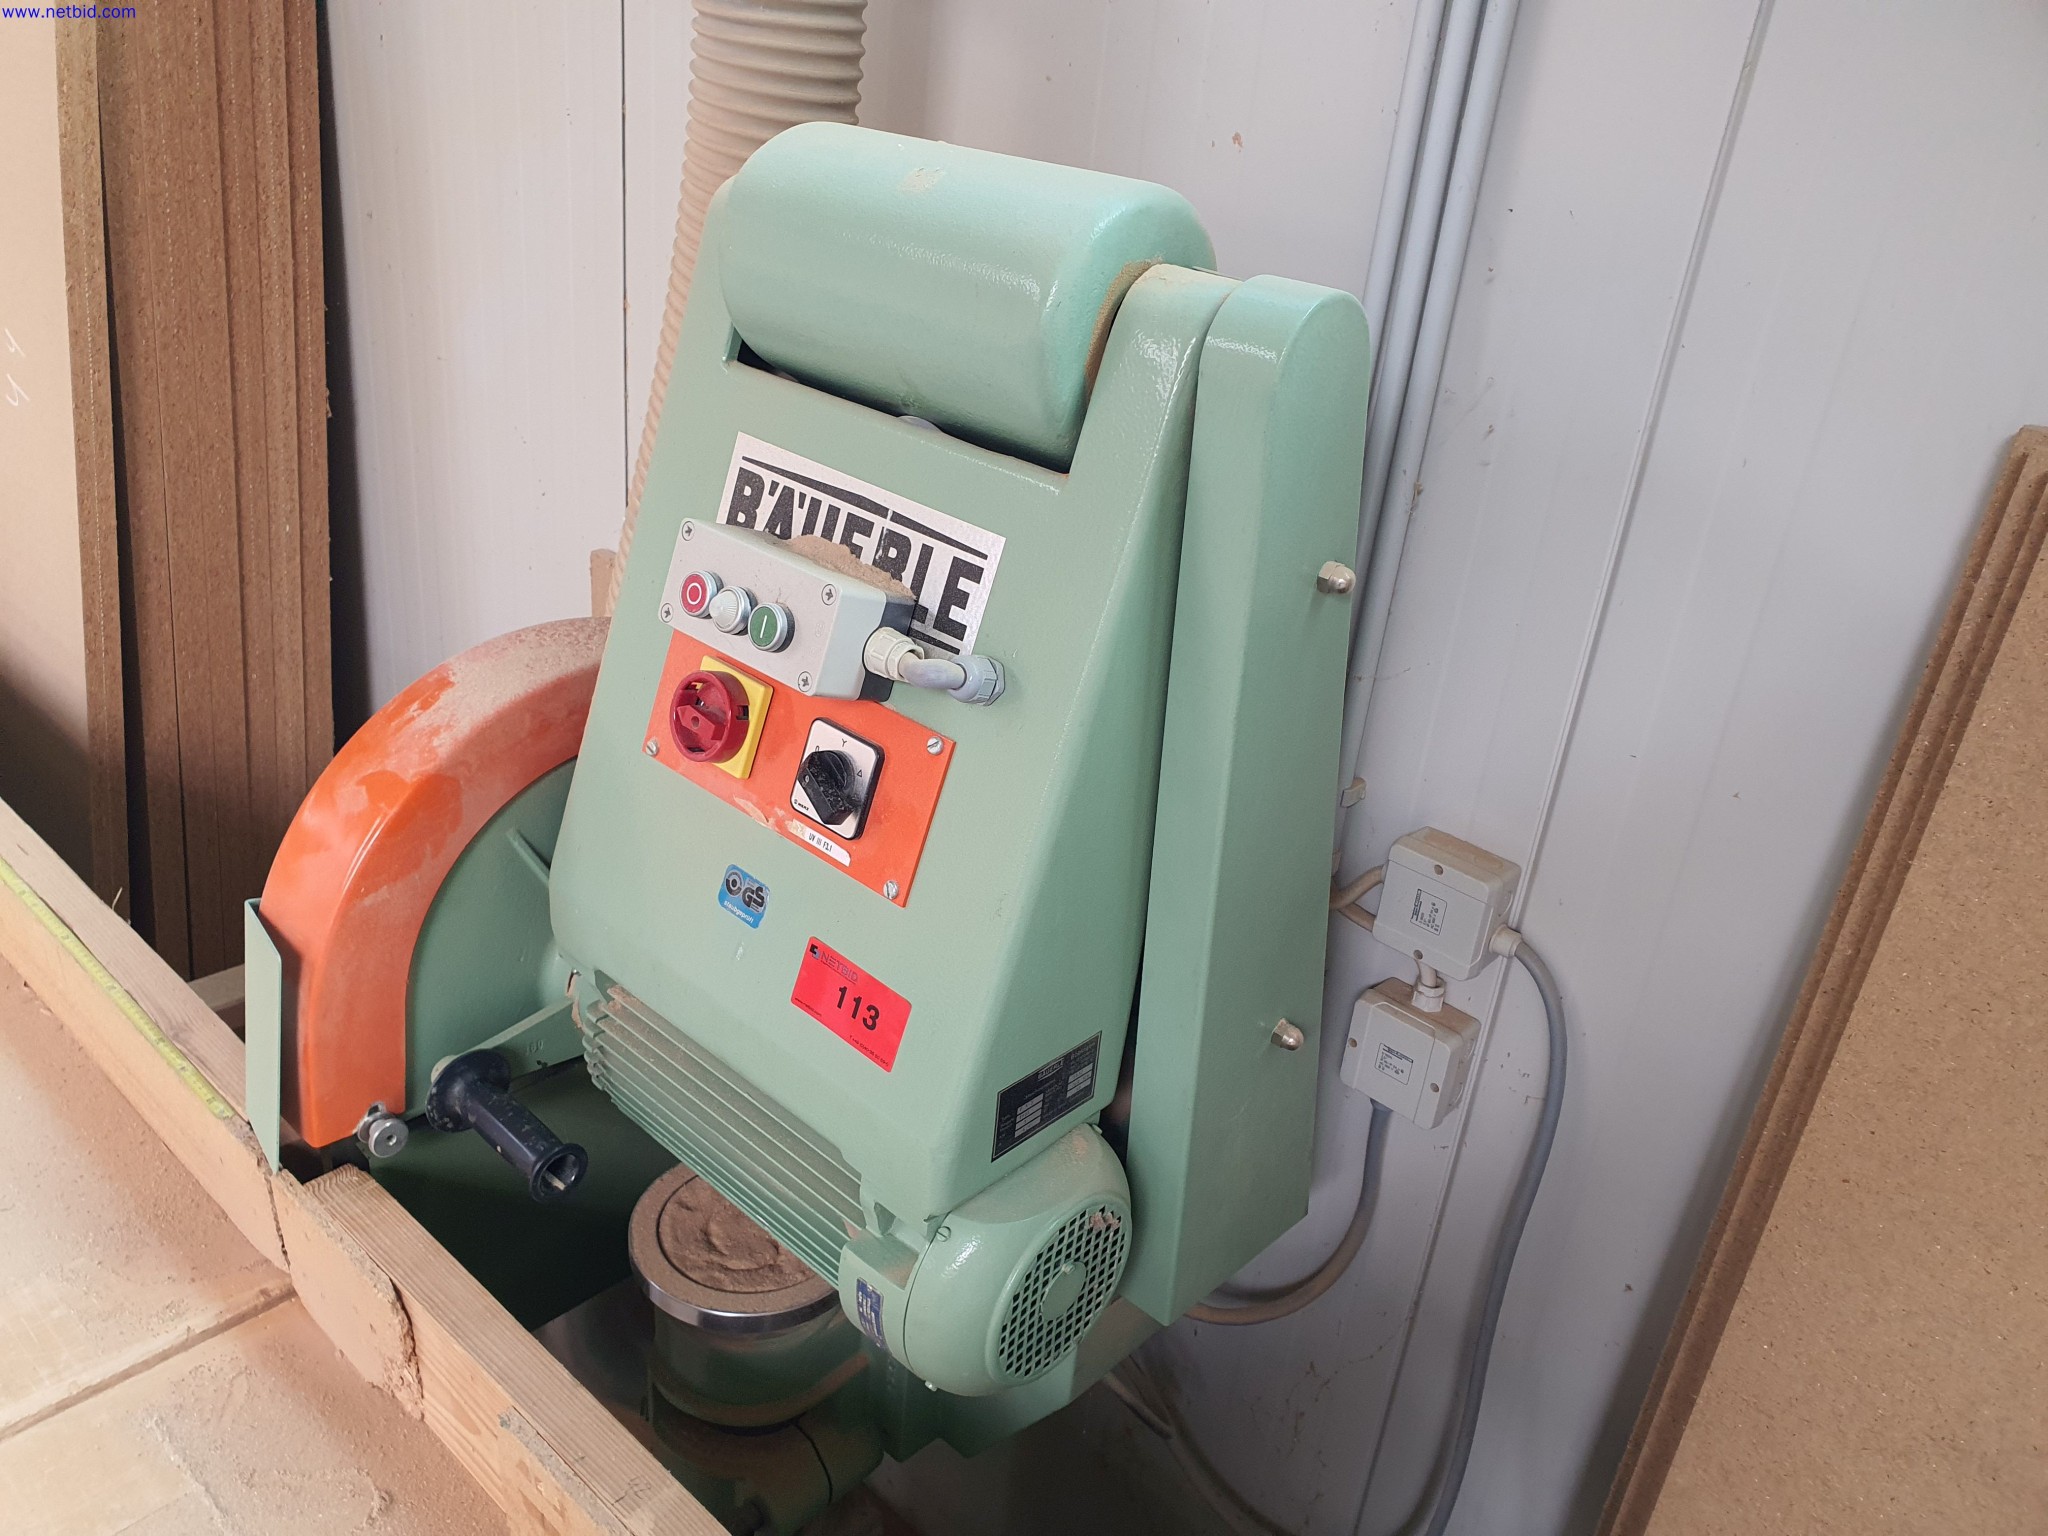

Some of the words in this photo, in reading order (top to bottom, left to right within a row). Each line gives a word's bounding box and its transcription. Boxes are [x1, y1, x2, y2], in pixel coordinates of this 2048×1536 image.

[742, 886, 765, 908] GS
[820, 951, 859, 983] NETBID
[836, 985, 880, 1031] 113
